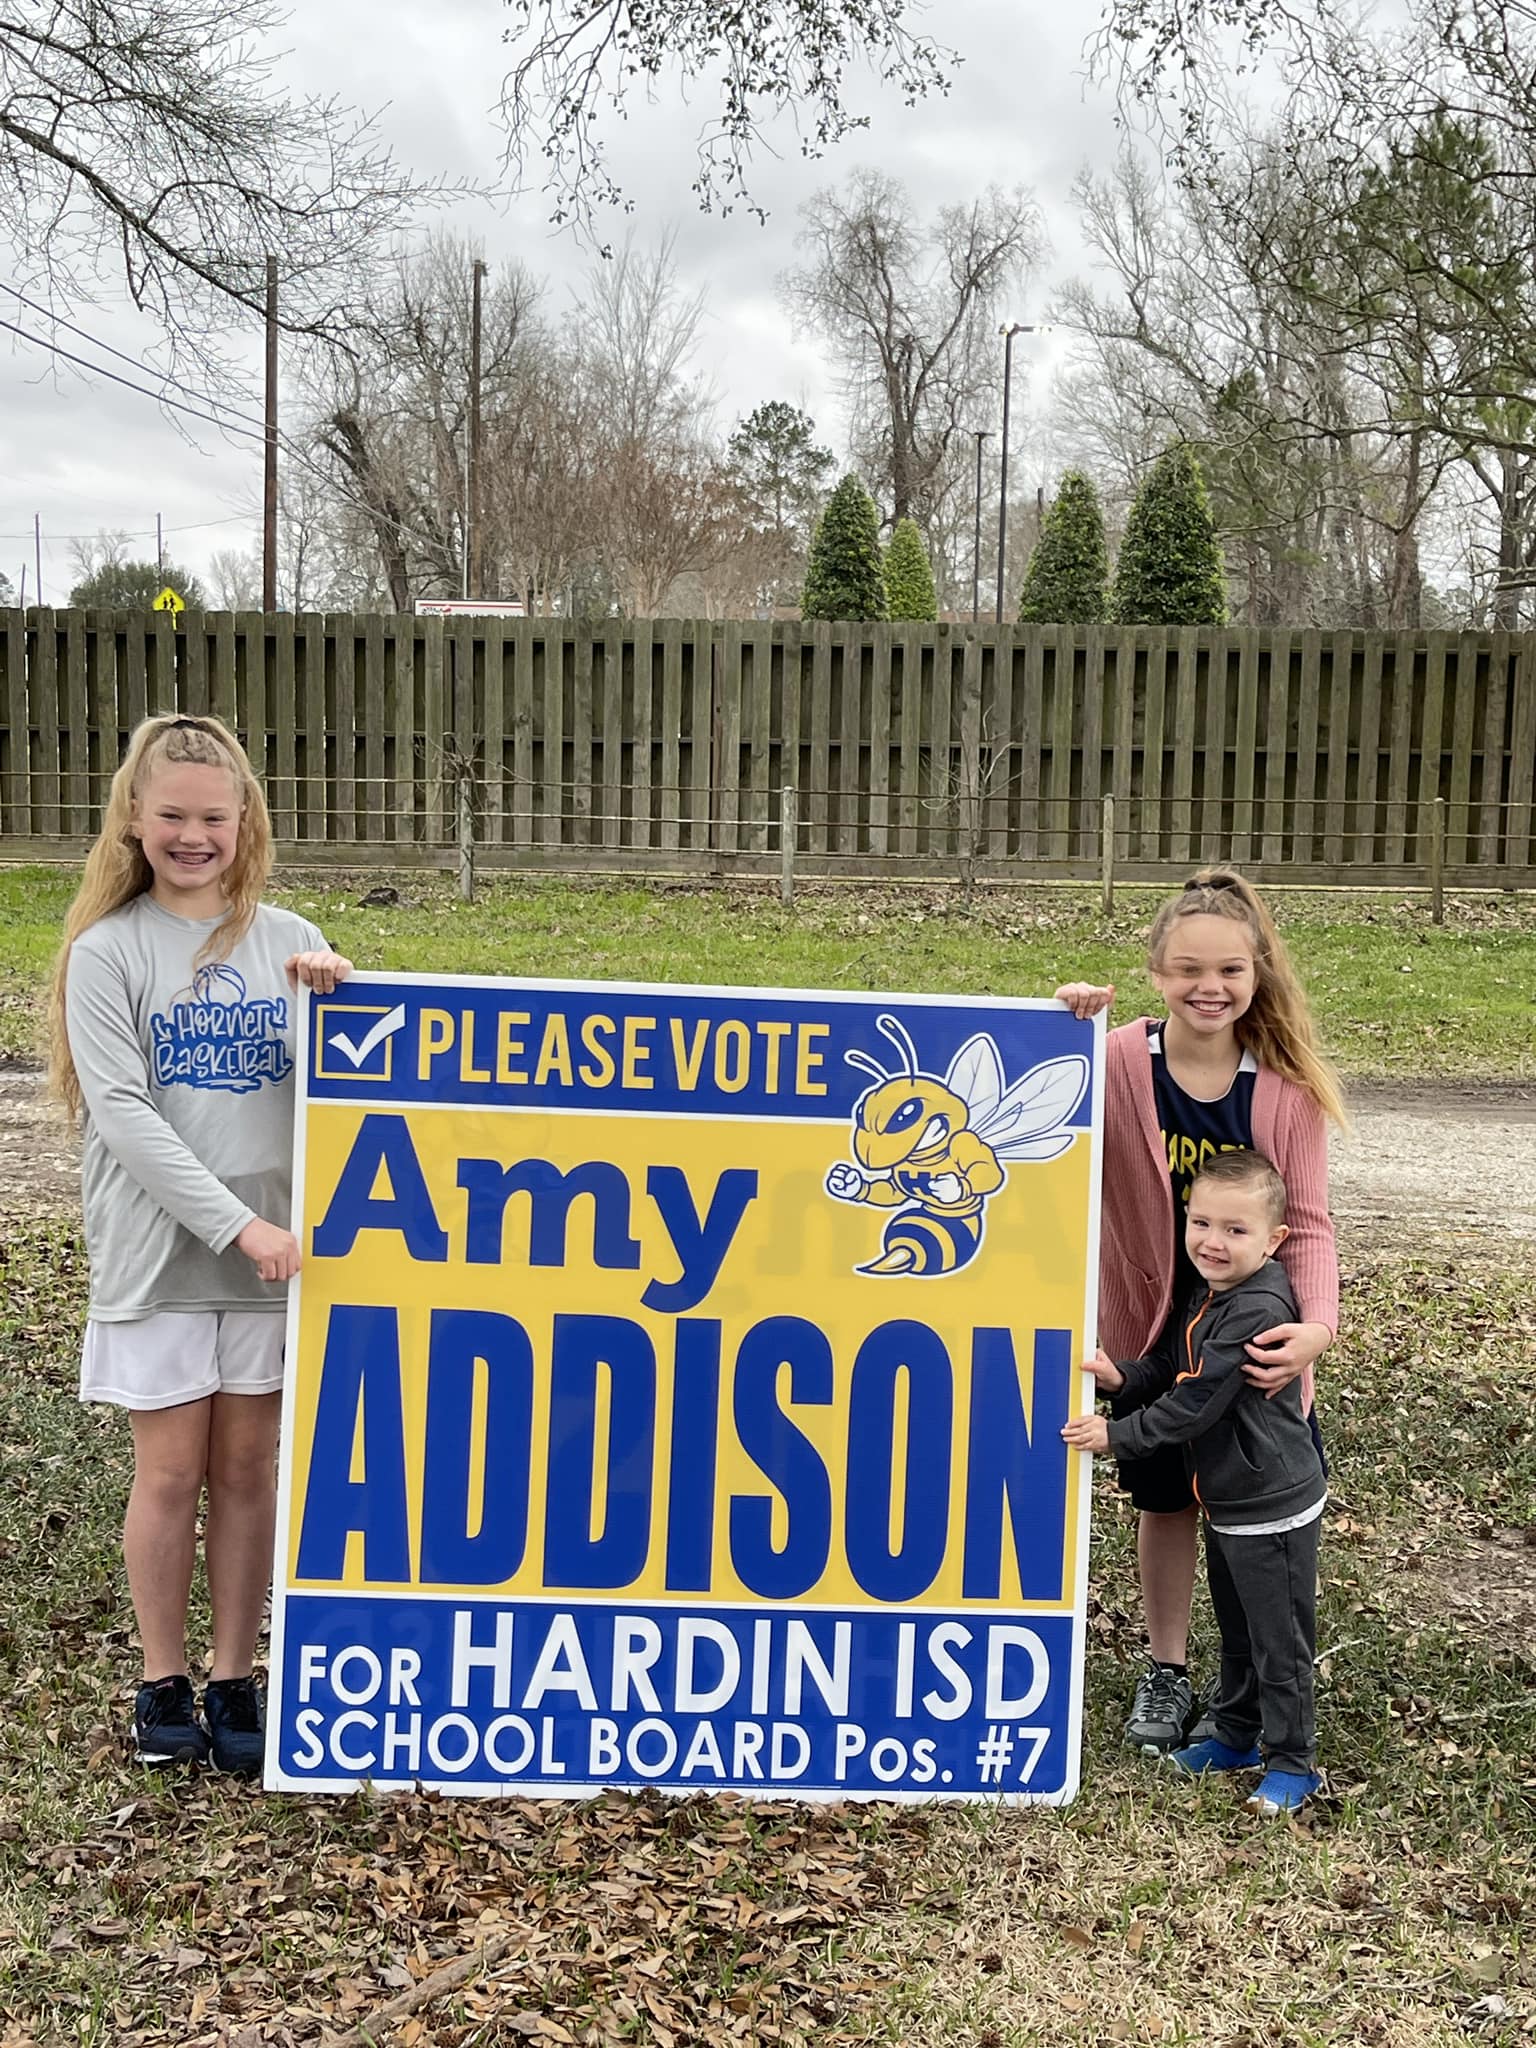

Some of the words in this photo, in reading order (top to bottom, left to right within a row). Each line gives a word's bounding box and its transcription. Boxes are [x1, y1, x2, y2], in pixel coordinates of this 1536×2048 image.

[418, 1008, 657, 1089] PLEASE
[670, 1018, 830, 1096] VOTE
[312, 1113, 759, 1313] Amy
[296, 1304, 1072, 1602] ADDISON
[299, 1645, 422, 1706] FOR
[451, 1610, 852, 1718] HARDIN
[895, 1621, 1050, 1721] ISD
[292, 1708, 566, 1775] SCHOOL
[589, 1717, 811, 1779] BOARD
[835, 1723, 953, 1783] Pos.
[976, 1725, 1051, 1784] #7
